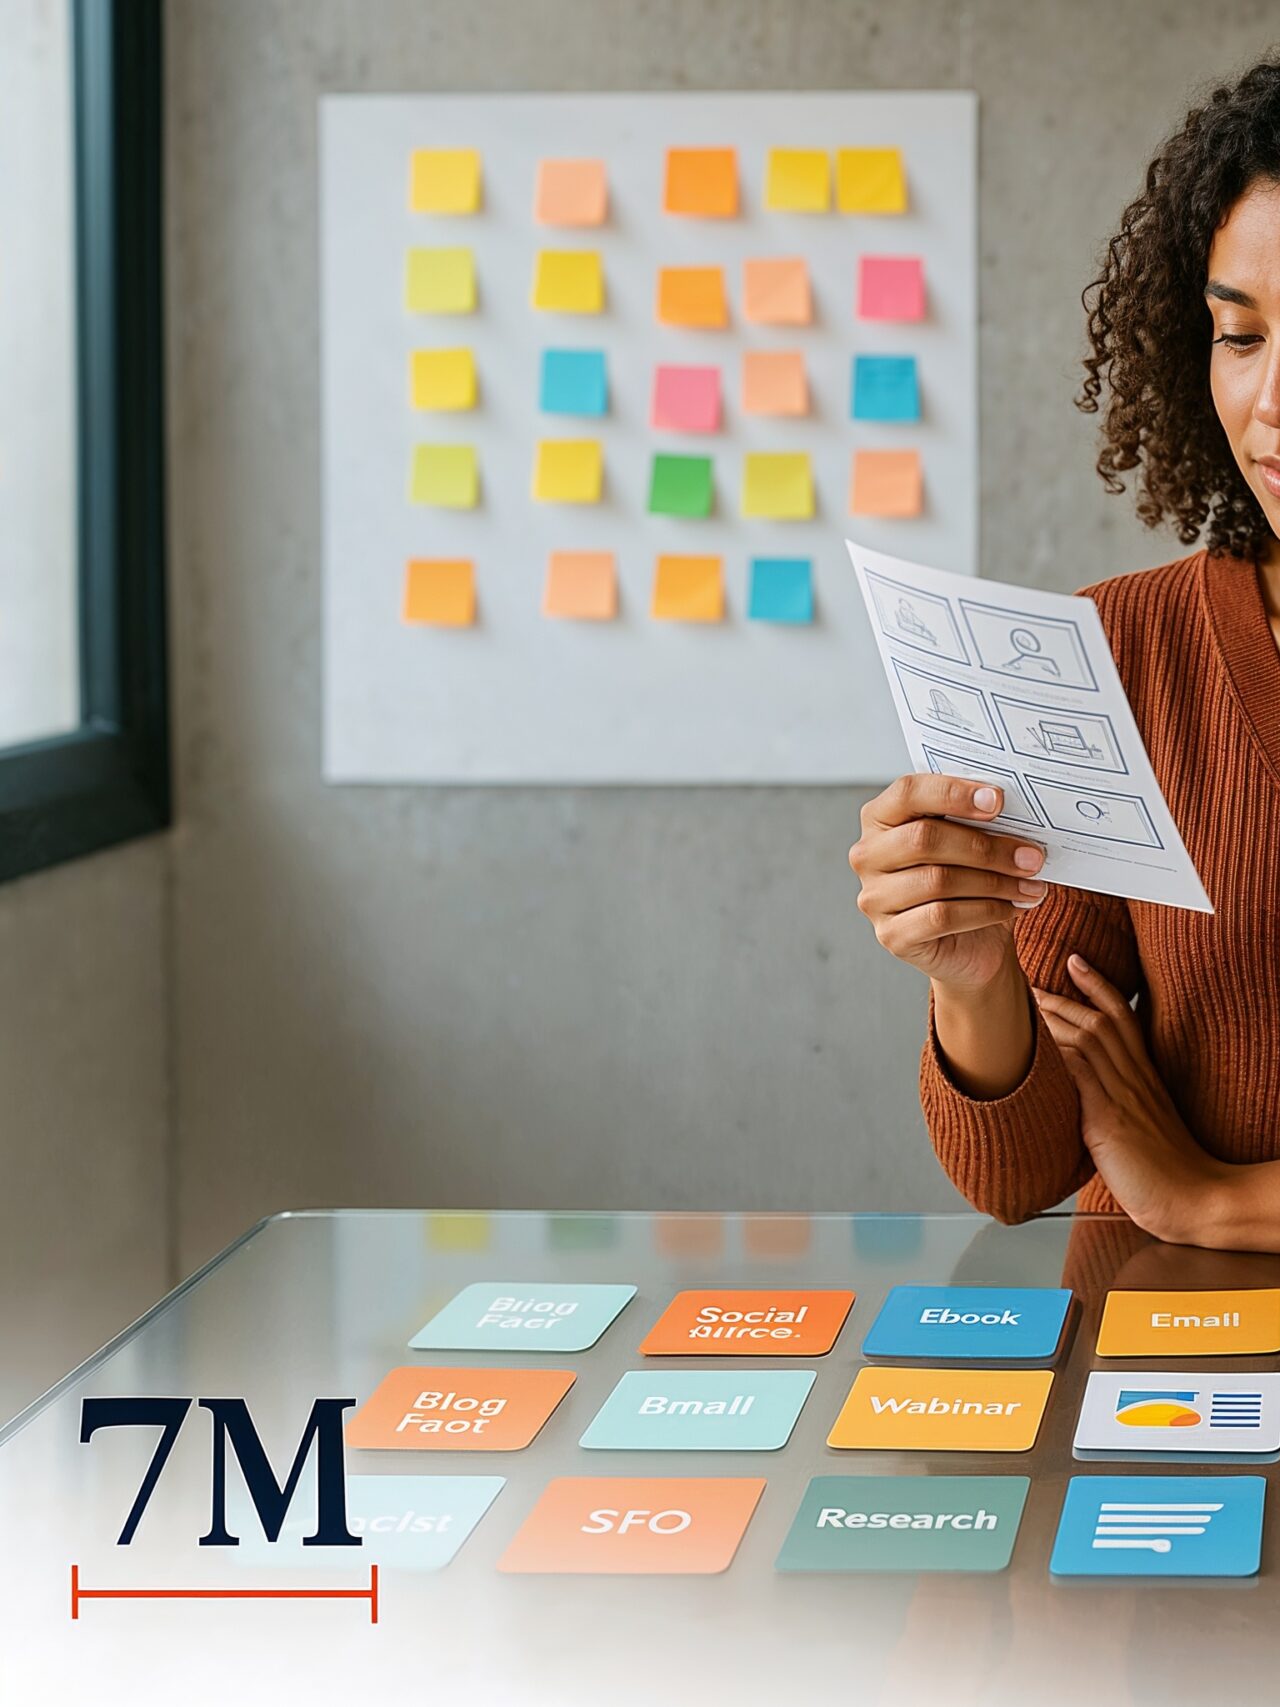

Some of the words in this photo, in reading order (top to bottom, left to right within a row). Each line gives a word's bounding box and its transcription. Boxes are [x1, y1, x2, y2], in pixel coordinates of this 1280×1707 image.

[696, 1306, 809, 1324] Social
[920, 1309, 1022, 1326] Ebook
[413, 1391, 508, 1417] Blog
[870, 1396, 1022, 1417] Wabinar
[581, 1509, 692, 1536] SFO
[816, 1508, 998, 1531] Research
